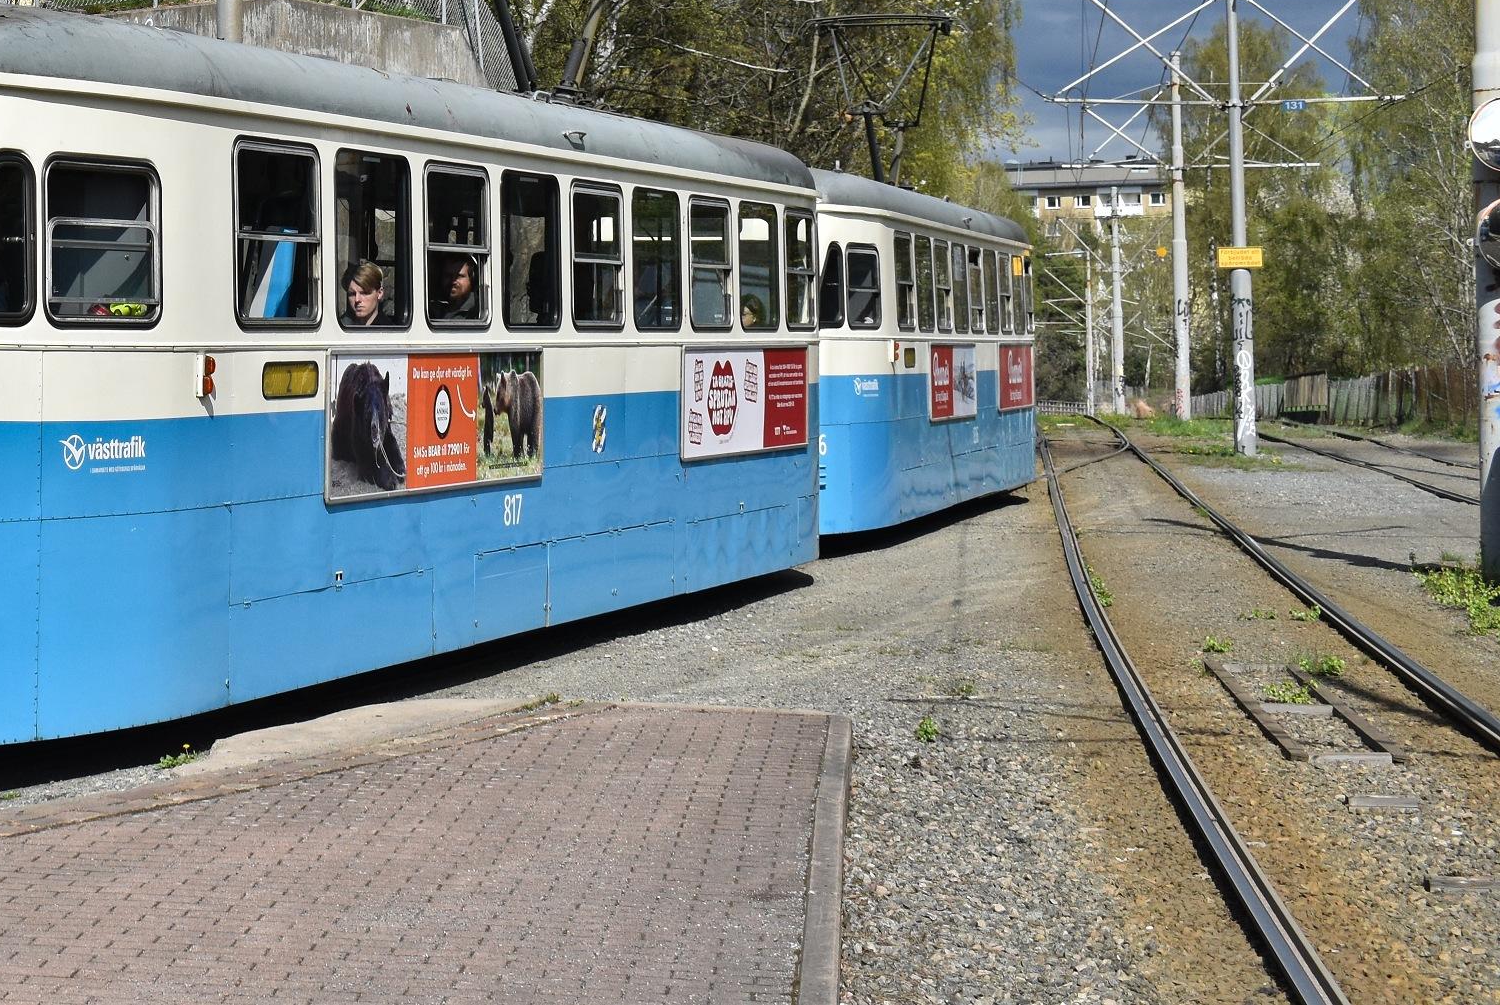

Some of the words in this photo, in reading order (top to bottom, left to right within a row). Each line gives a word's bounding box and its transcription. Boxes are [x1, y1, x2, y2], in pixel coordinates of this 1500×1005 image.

[1285, 101, 1303, 110] 131
[412, 367, 420, 379] Du
[420, 366, 429, 379] kan
[429, 370, 435, 382] ge
[435, 366, 445, 382] djur
[708, 388, 736, 410] SPRUTAN
[712, 409, 723, 426] MOT
[88, 436, 146, 460] västtrafik
[428, 444, 441, 457] BEAR
[447, 443, 463, 456] 72901
[423, 466, 430, 478] ge
[430, 462, 438, 474] 100
[503, 493, 523, 526] 817
